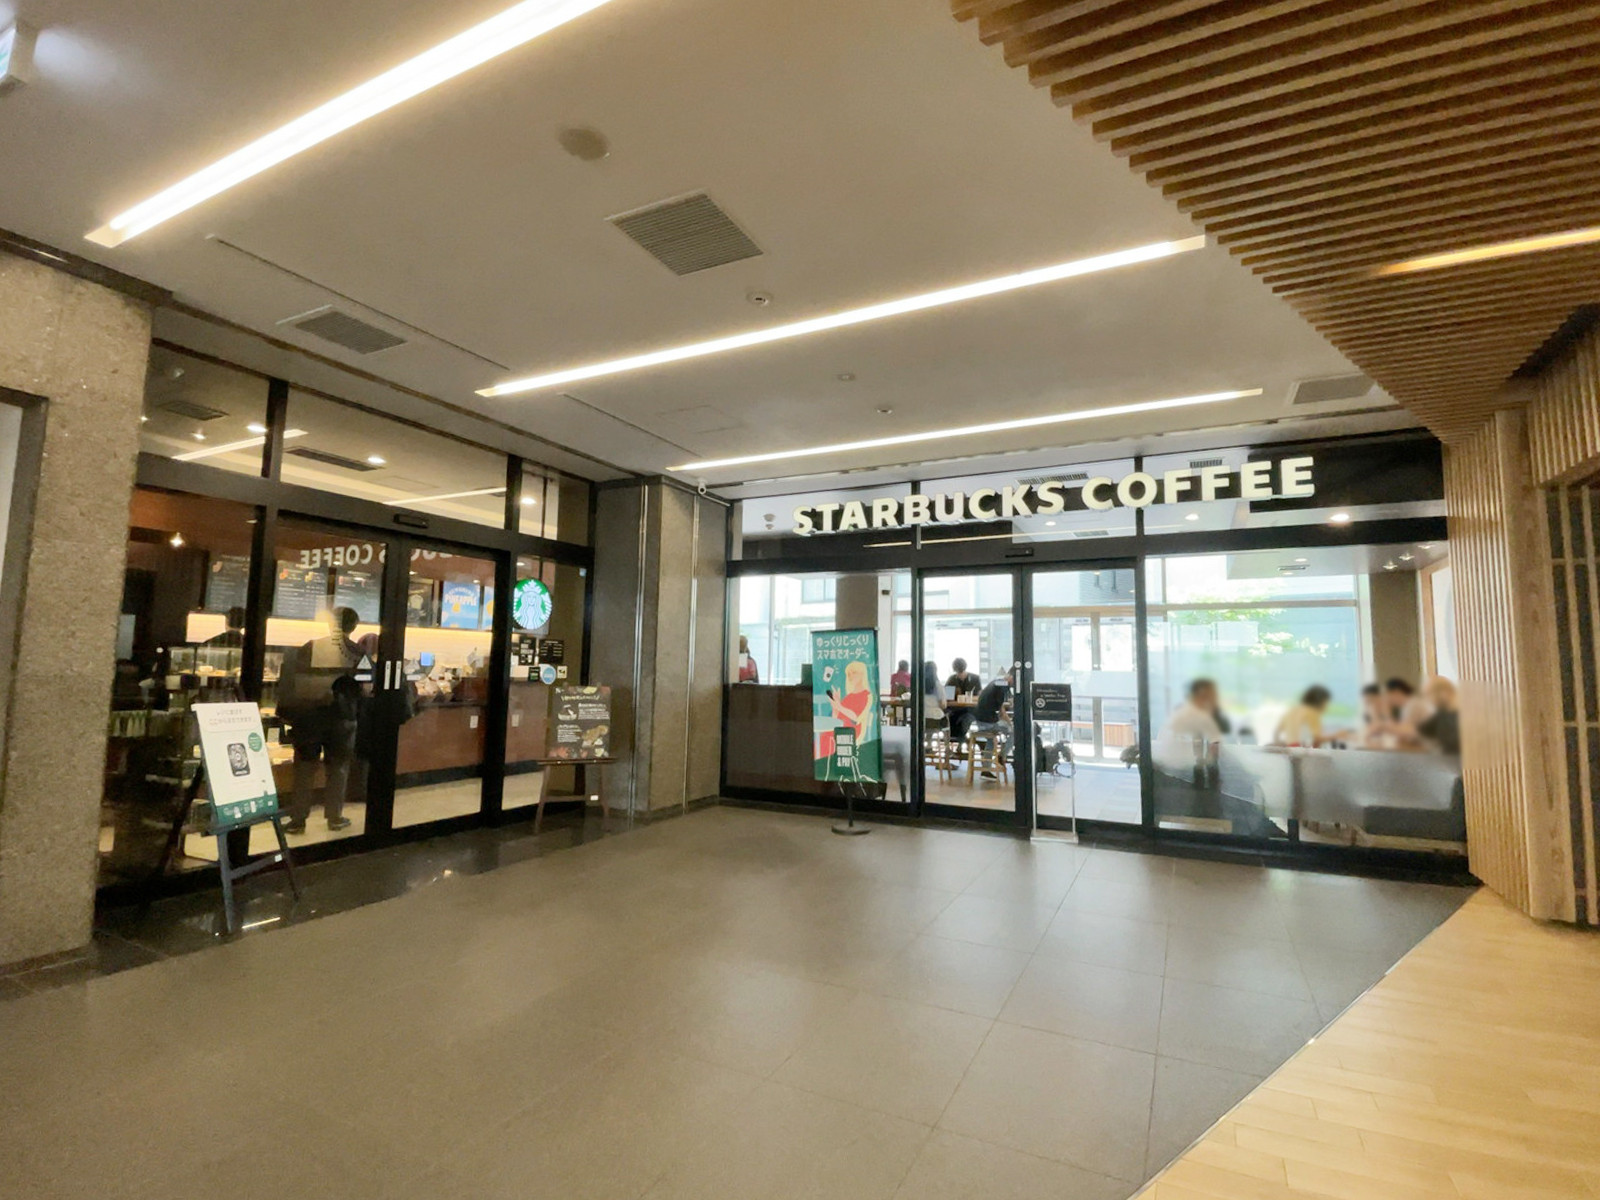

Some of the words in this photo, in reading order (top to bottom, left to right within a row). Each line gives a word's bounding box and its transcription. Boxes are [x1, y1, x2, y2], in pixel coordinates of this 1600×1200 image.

[792, 481, 1065, 535] STARBUCKS
[1081, 456, 1315, 508] COFFEE
[816, 634, 869, 648] ゆっくりじっくり
